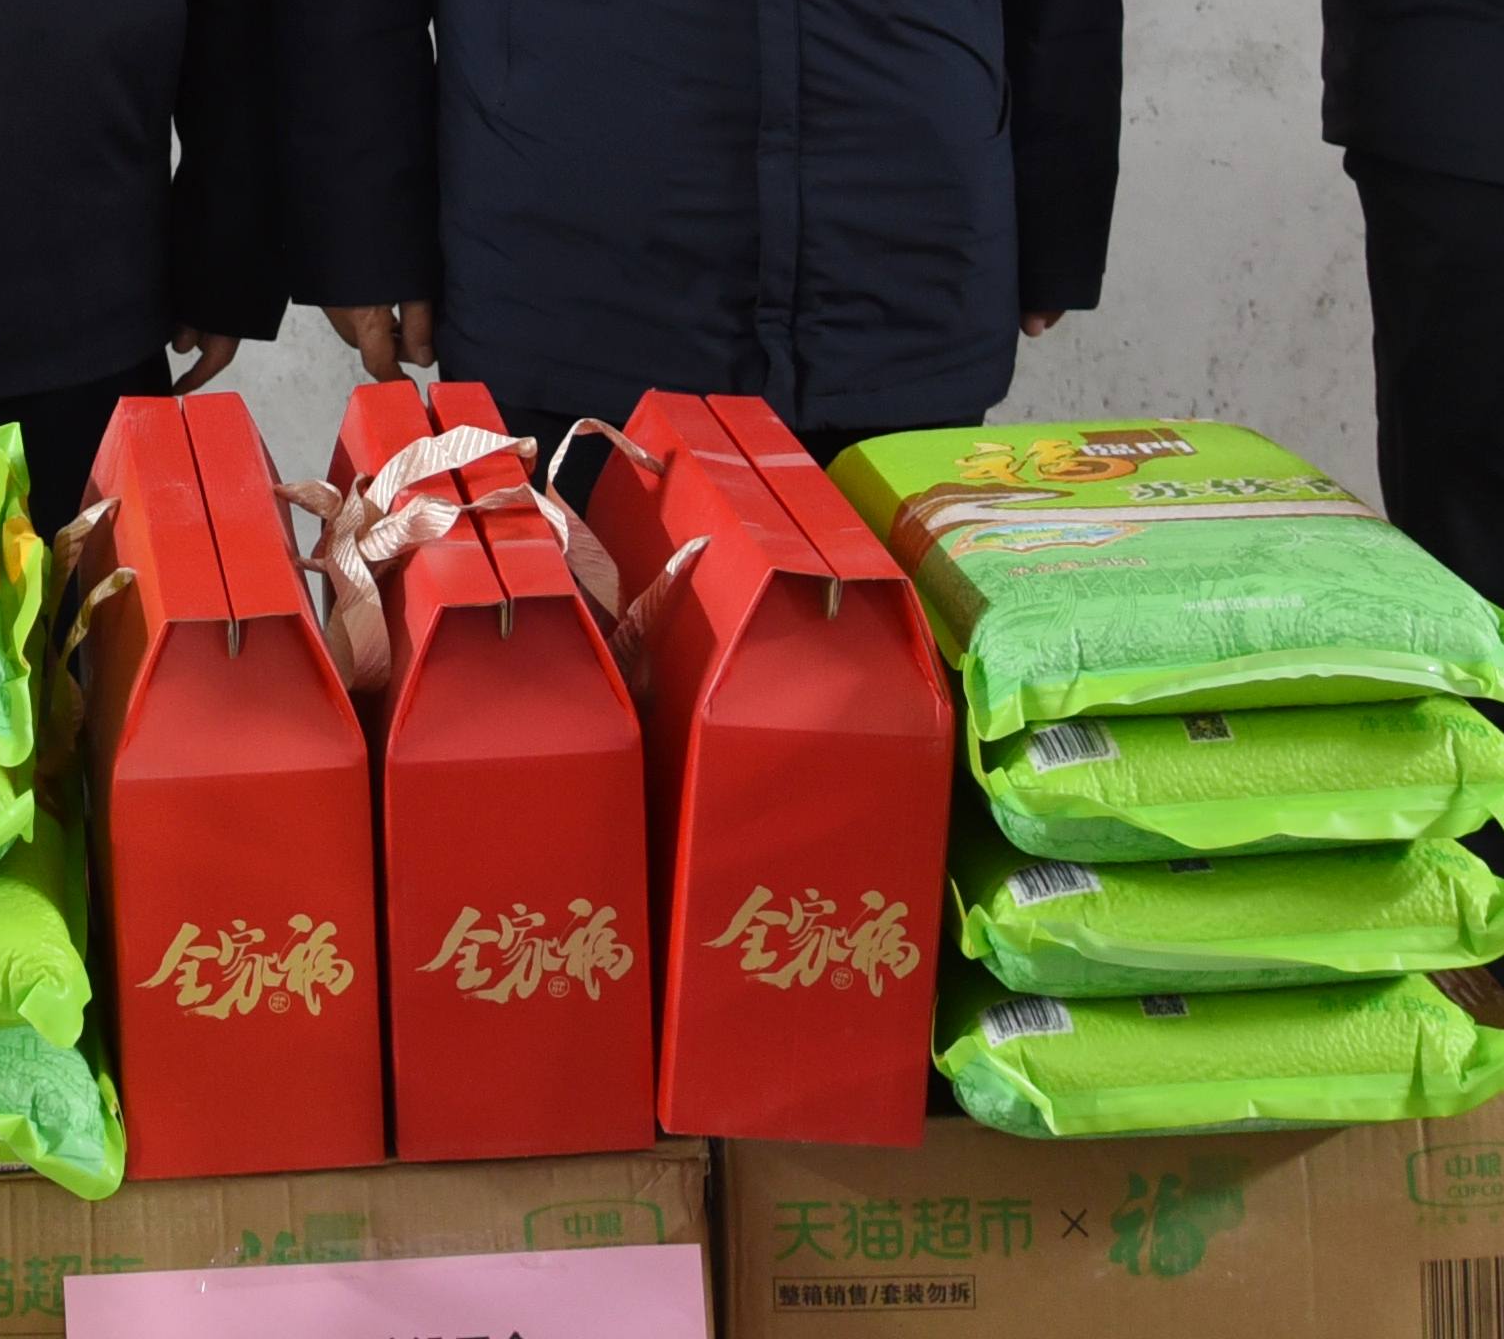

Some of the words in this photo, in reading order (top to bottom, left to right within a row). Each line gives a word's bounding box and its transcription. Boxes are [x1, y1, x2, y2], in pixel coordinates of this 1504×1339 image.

[135, 913, 355, 1020] 全家福
[414, 898, 635, 1003] 全家福
[703, 885, 921, 998] 全家福
[773, 1198, 1034, 1262] 天猫超市
